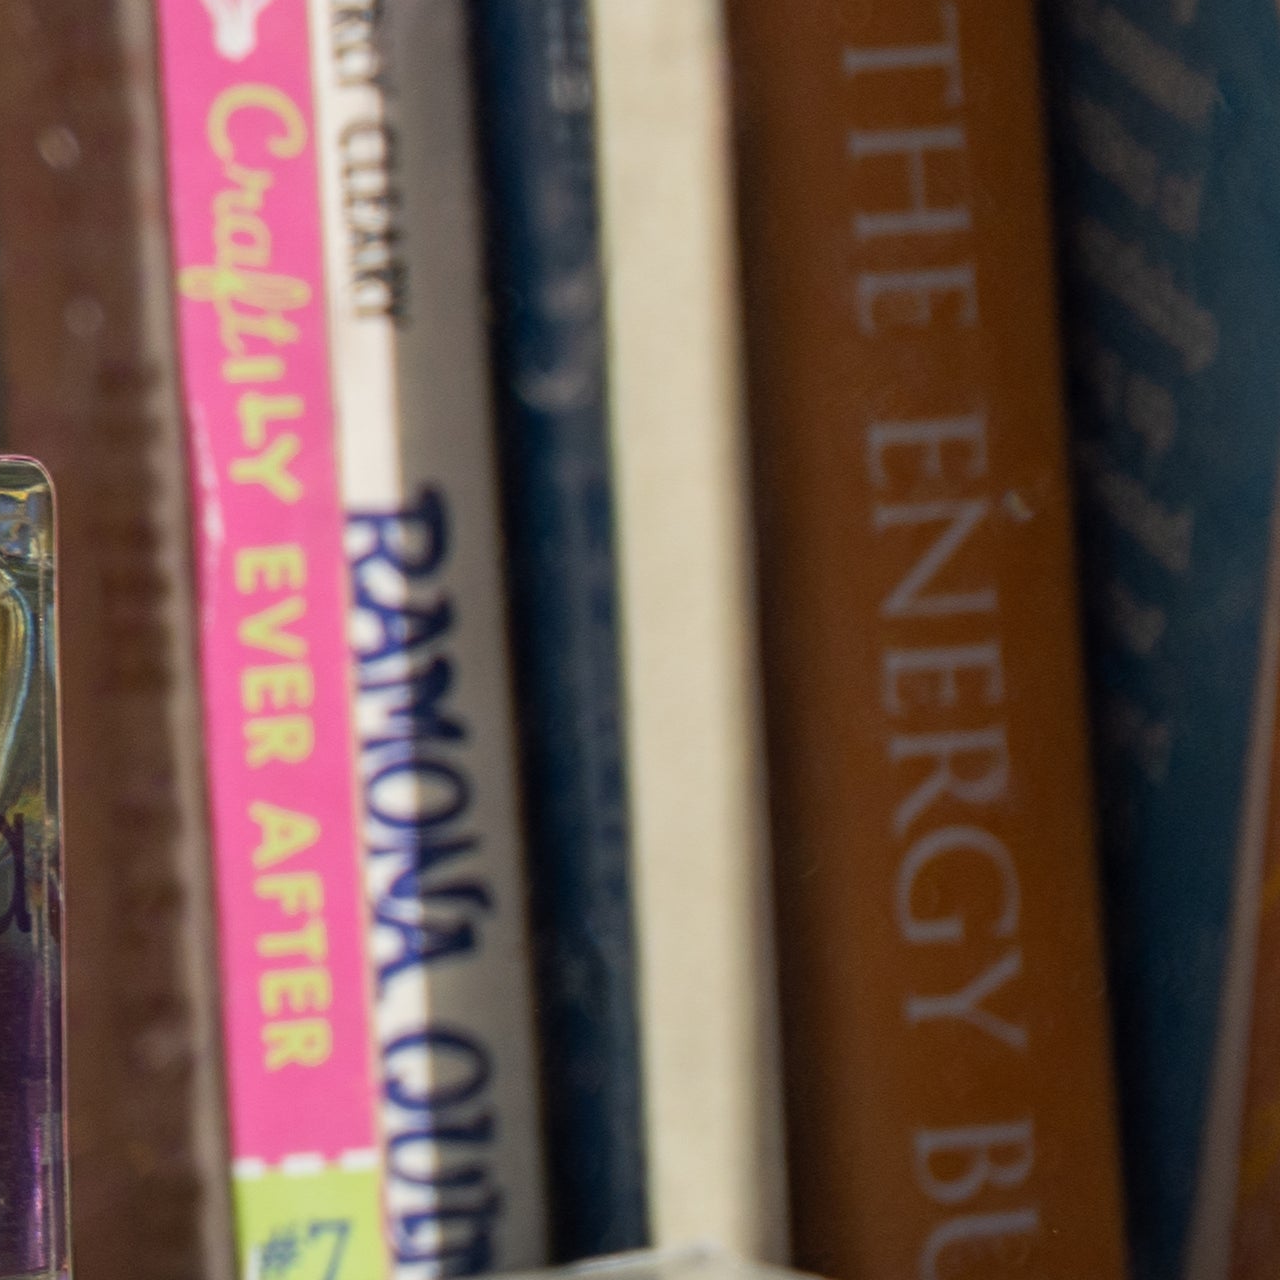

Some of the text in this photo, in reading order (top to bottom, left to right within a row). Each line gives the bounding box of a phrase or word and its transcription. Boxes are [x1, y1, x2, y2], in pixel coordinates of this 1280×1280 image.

[339, 120, 408, 330] CLEARY
[236, 544, 315, 768] EVER
[346, 483, 492, 1000] RAMONA
[867, 408, 1029, 1051] ENERGY
[249, 799, 333, 1073] AFTER
